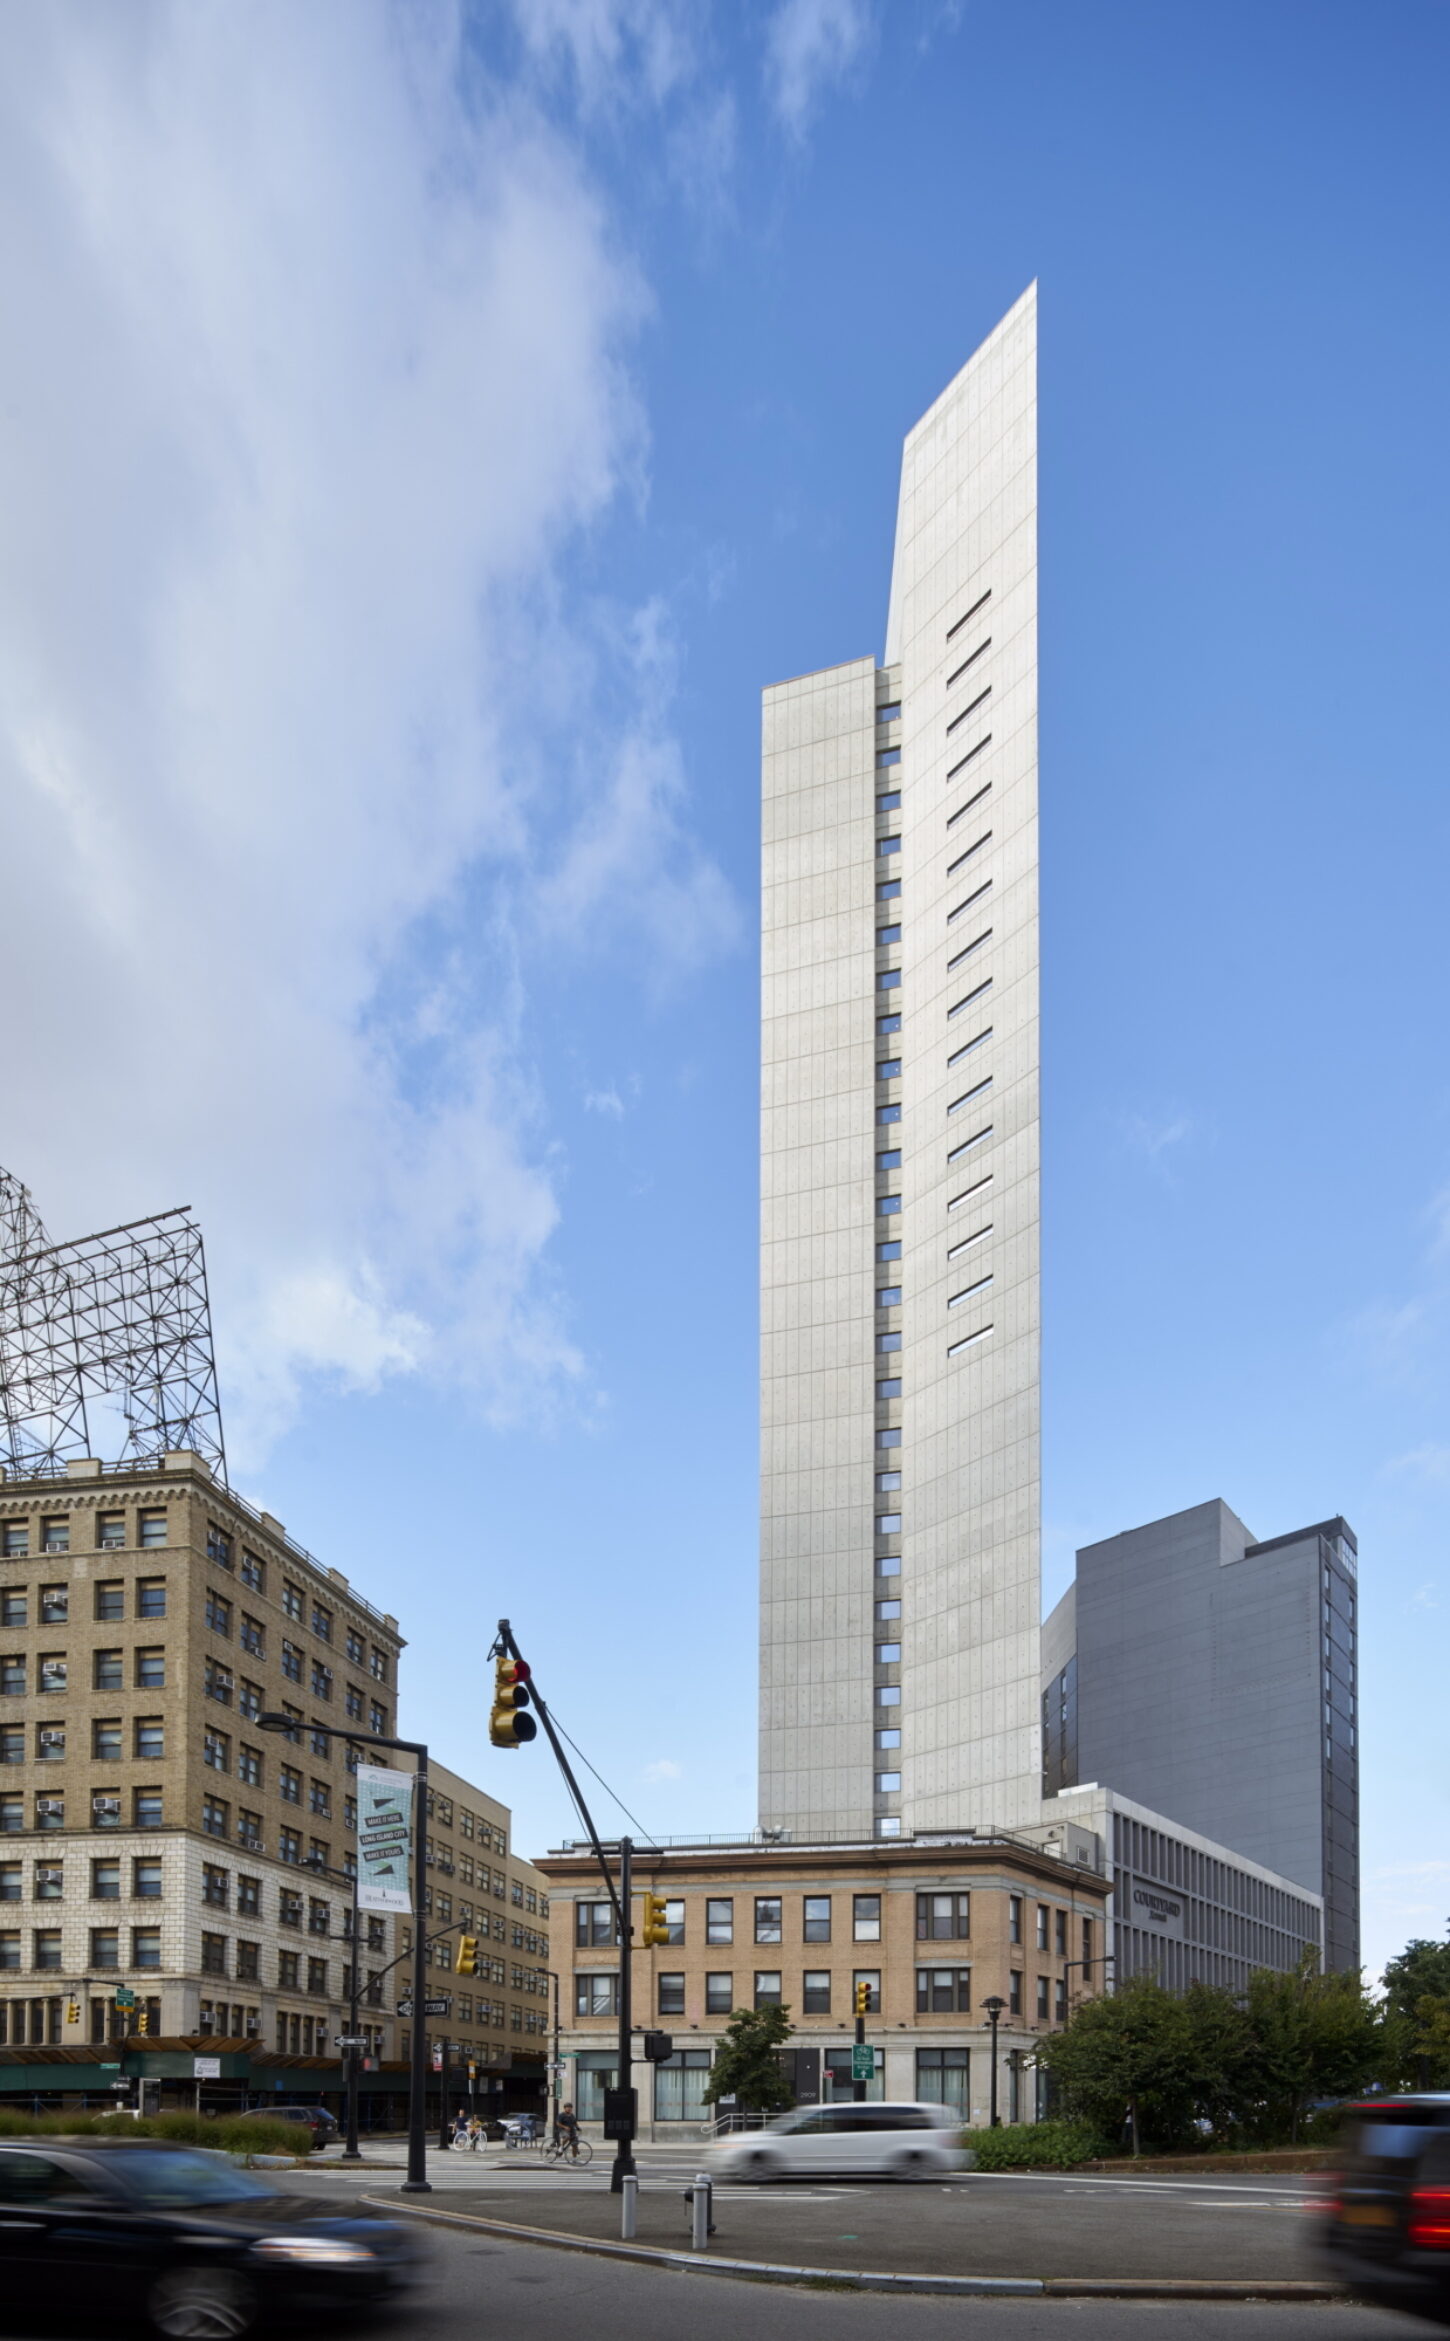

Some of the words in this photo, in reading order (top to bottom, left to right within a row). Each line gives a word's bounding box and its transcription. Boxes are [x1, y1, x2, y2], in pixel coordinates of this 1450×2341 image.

[367, 1817, 382, 1825] MAKE
[387, 1814, 401, 1822] HERE
[362, 1835, 376, 1843] LONG
[376, 1832, 394, 1841] ISLAND
[394, 1830, 405, 1838] CITY
[365, 1852, 380, 1860] MAKE
[385, 1847, 401, 1856] YOURS
[1134, 1889, 1180, 1917] COURTYARD
